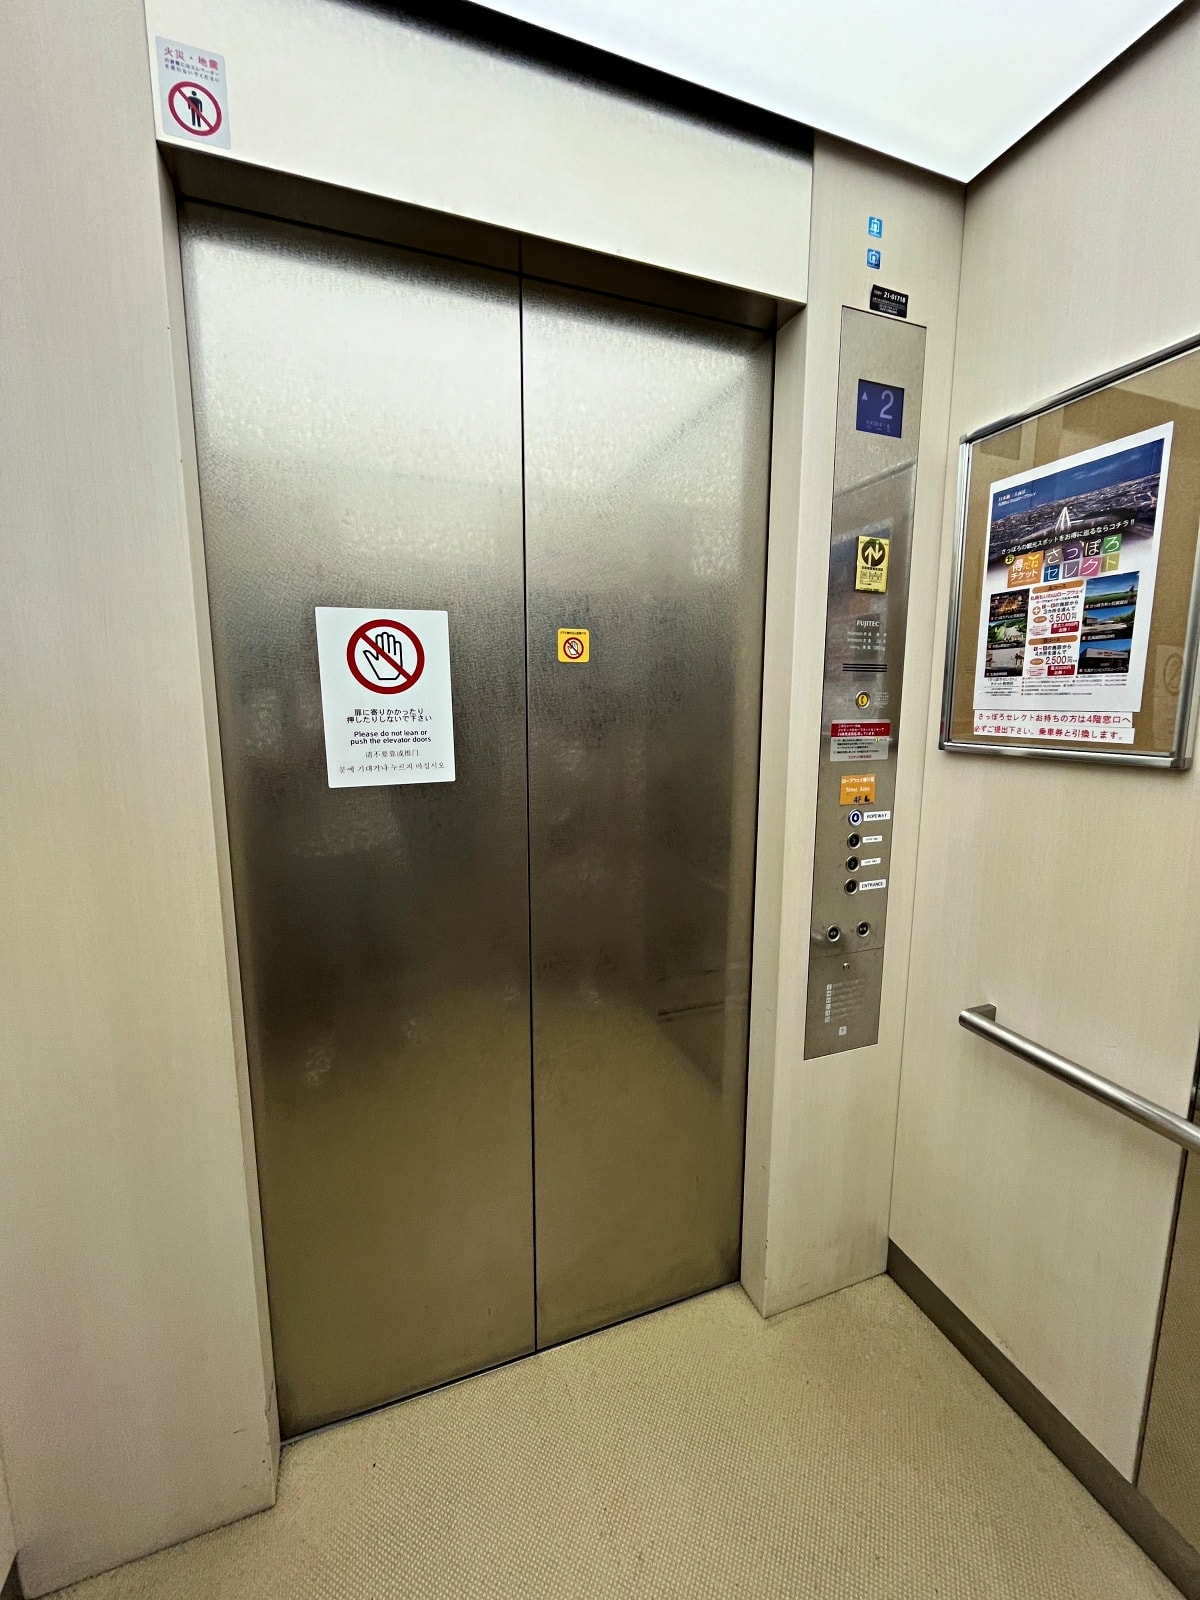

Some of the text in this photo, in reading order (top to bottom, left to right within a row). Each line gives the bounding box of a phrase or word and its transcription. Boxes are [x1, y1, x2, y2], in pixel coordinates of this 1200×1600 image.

[880, 389, 894, 420] 2
[1046, 536, 1120, 564] さっぽろ
[1045, 556, 1116, 581] セレクト
[1010, 569, 1038, 581] チケット
[1049, 612, 1071, 623] 3,500
[856, 620, 880, 628] FUJITEC
[1045, 656, 1067, 665] 2,500
[354, 708, 424, 717] 扉に寄りかかったり
[347, 715, 432, 724] 押したりしないで下さい
[978, 713, 1132, 725] さっぽろセレクトお持ちの方は4階窓口へ
[350, 738, 368, 746] push
[861, 881, 884, 889] ENTRANCE
